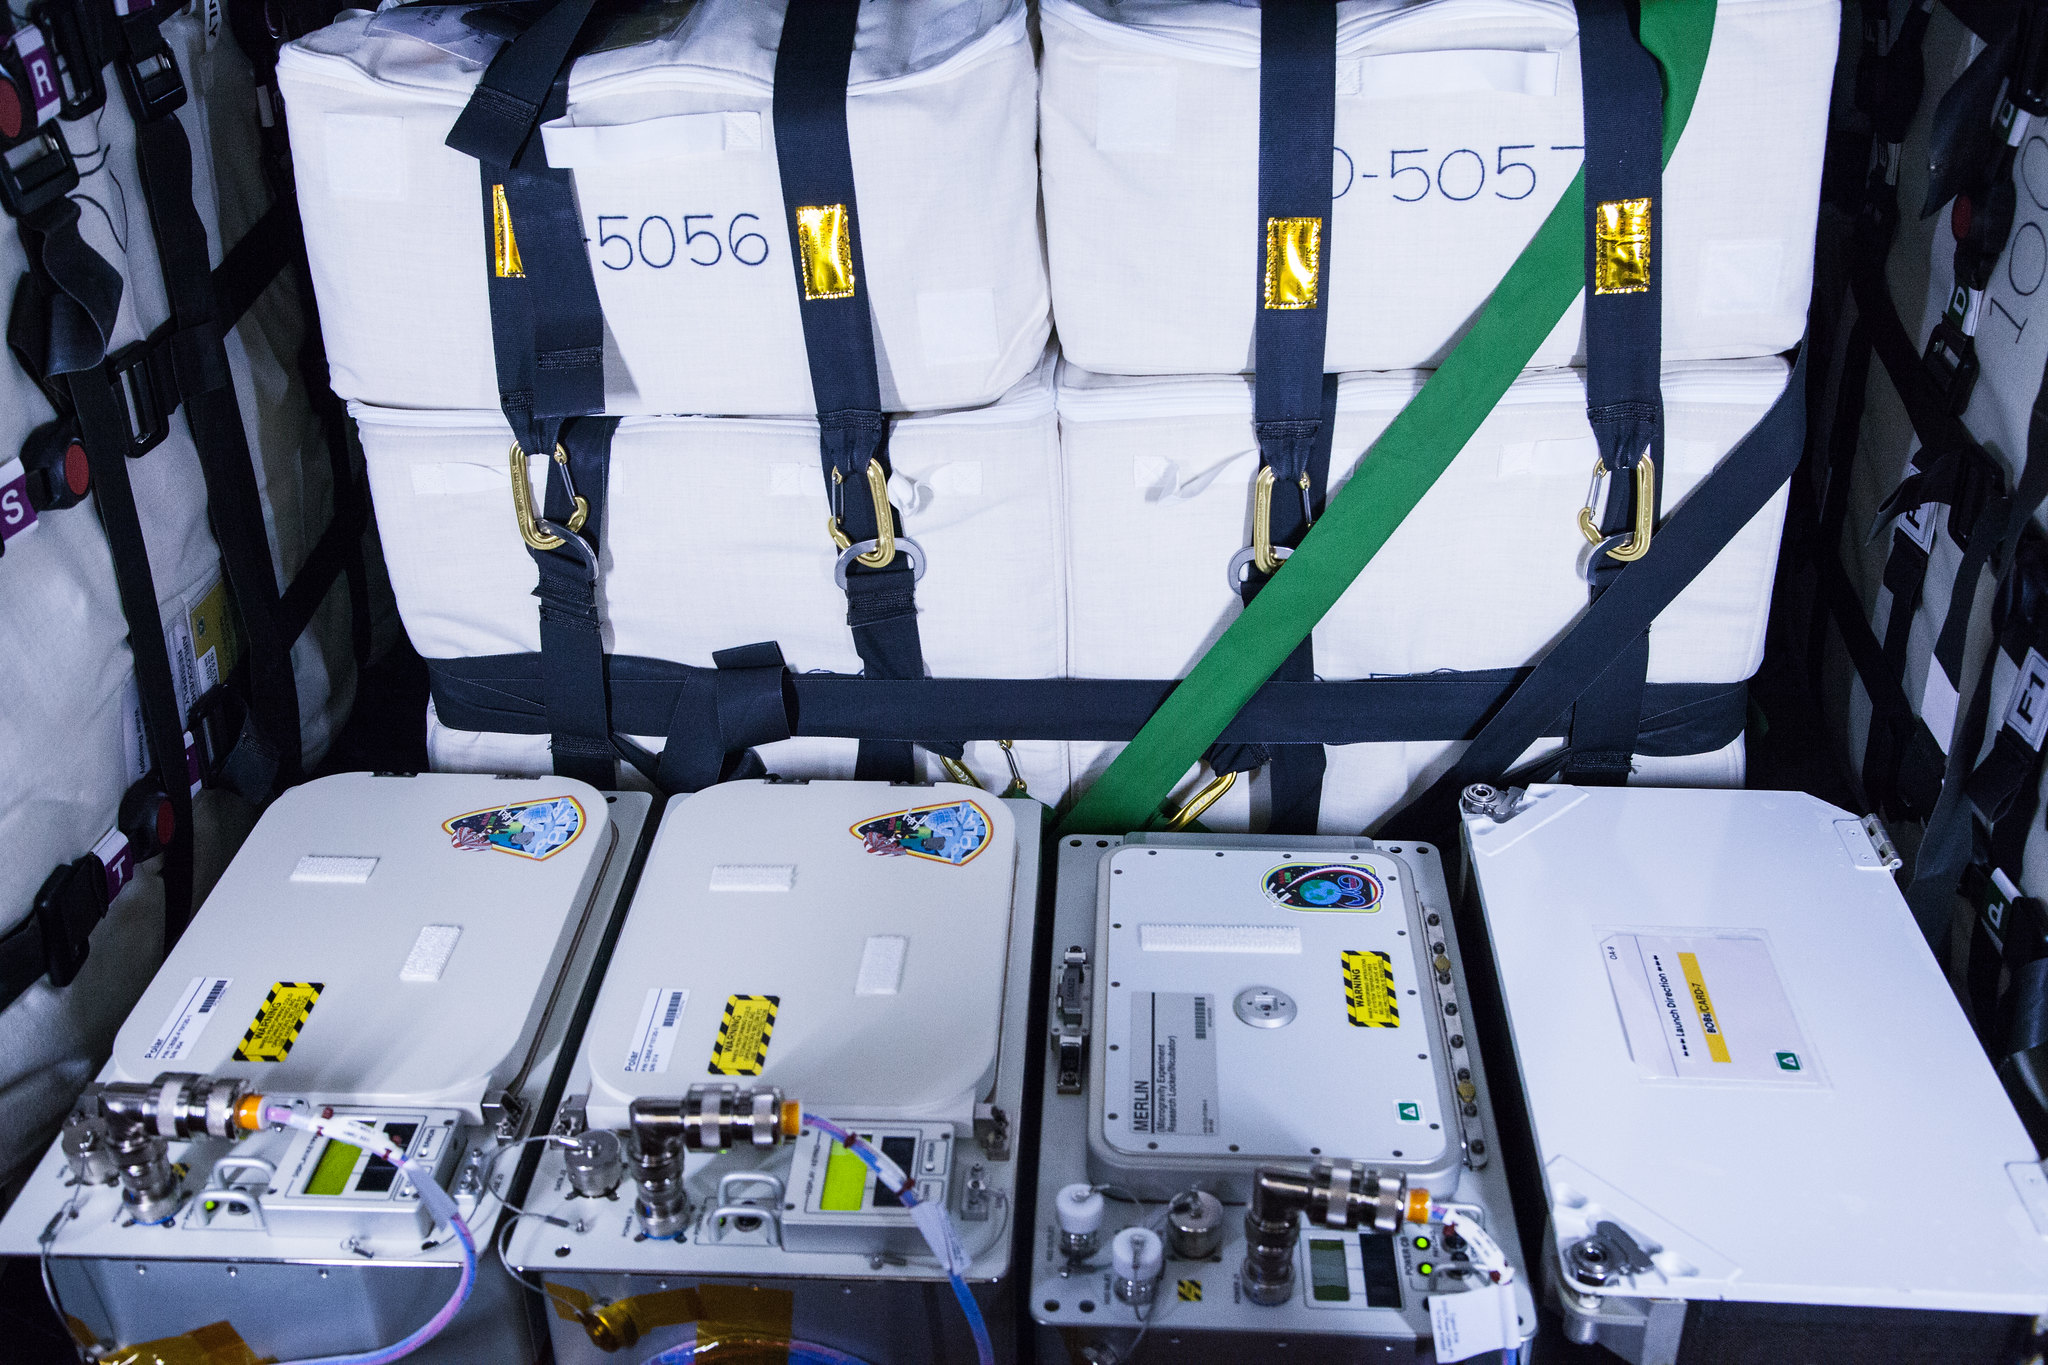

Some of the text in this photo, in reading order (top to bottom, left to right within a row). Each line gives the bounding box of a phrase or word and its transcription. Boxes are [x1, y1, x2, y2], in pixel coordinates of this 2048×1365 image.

[31, 59, 53, 97] R
[1953, 286, 1966, 316] D
[2, 489, 24, 524] S
[2017, 671, 2045, 724] F1
[112, 855, 126, 886] T
[1987, 901, 2004, 929] P
[1352, 969, 1365, 1007] WARNING
[1659, 973, 1685, 1037] Launch Direction
[253, 1002, 281, 1040] WARNING
[1692, 983, 1717, 1034] BOBs/CARD-7
[144, 1038, 164, 1059] Polar
[725, 1015, 742, 1053] WARNING
[624, 1051, 639, 1072] Polar
[1156, 1044, 1166, 1083] Experiment
[1133, 1080, 1148, 1131] MERLIN
[1167, 1096, 1176, 1132] Research
